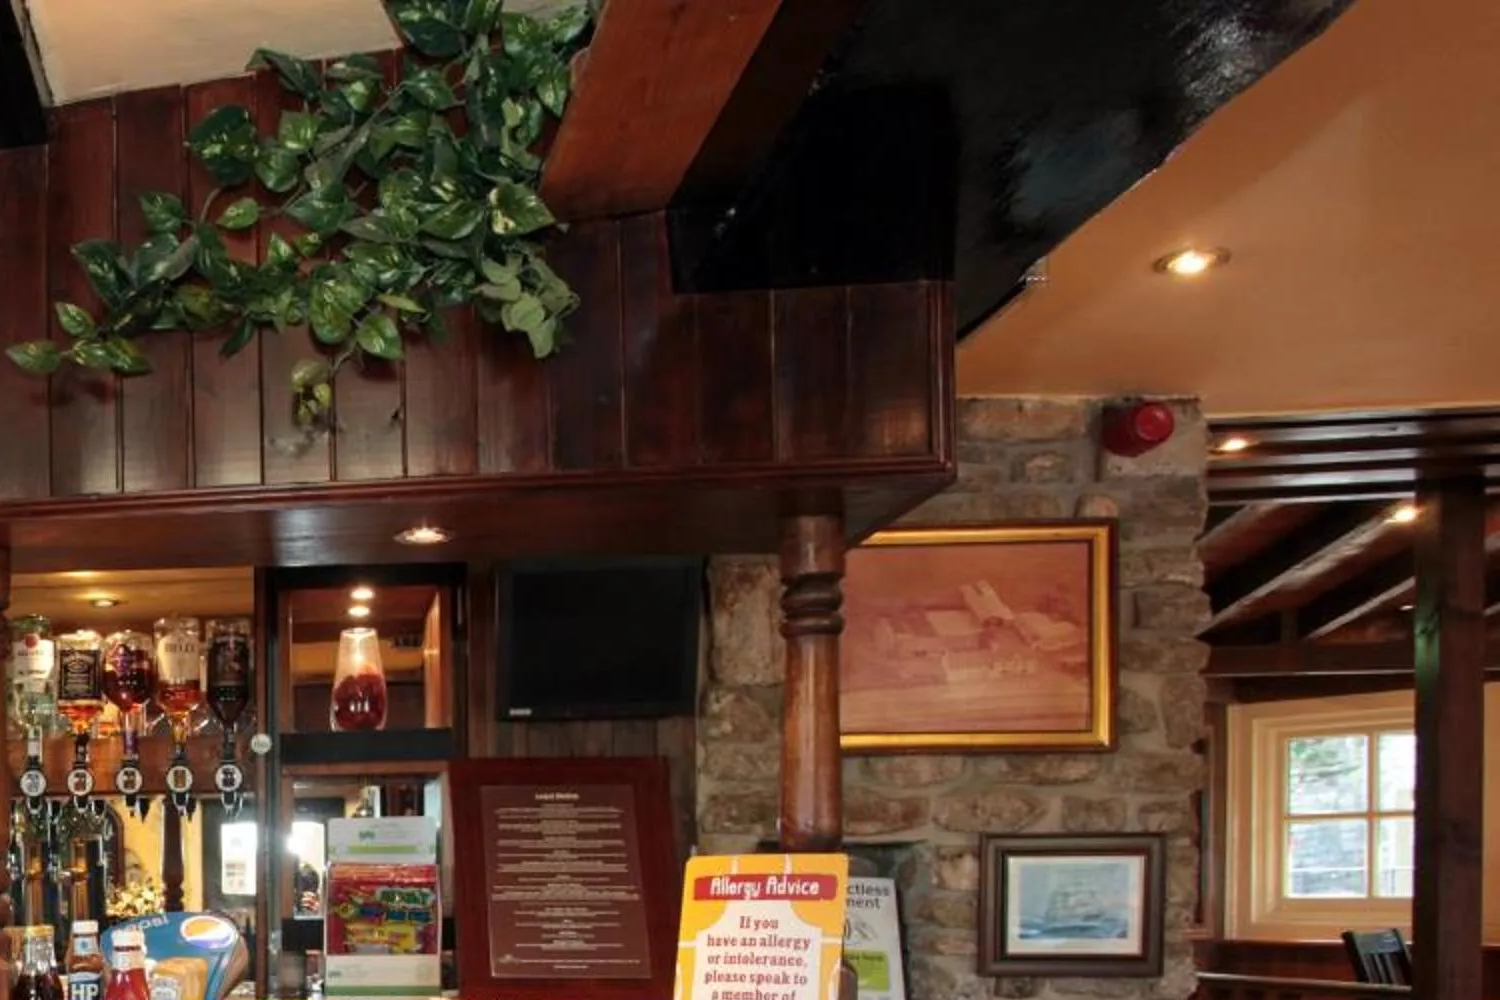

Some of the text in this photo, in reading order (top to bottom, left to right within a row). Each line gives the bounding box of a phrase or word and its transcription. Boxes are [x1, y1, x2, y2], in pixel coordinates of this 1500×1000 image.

[709, 875, 820, 899] Allergy Advice
[739, 916, 779, 930] If you
[707, 934, 811, 951] have an allergy
[707, 955, 721, 965] or
[704, 970, 808, 985] please speak to
[711, 990, 719, 1000] a
